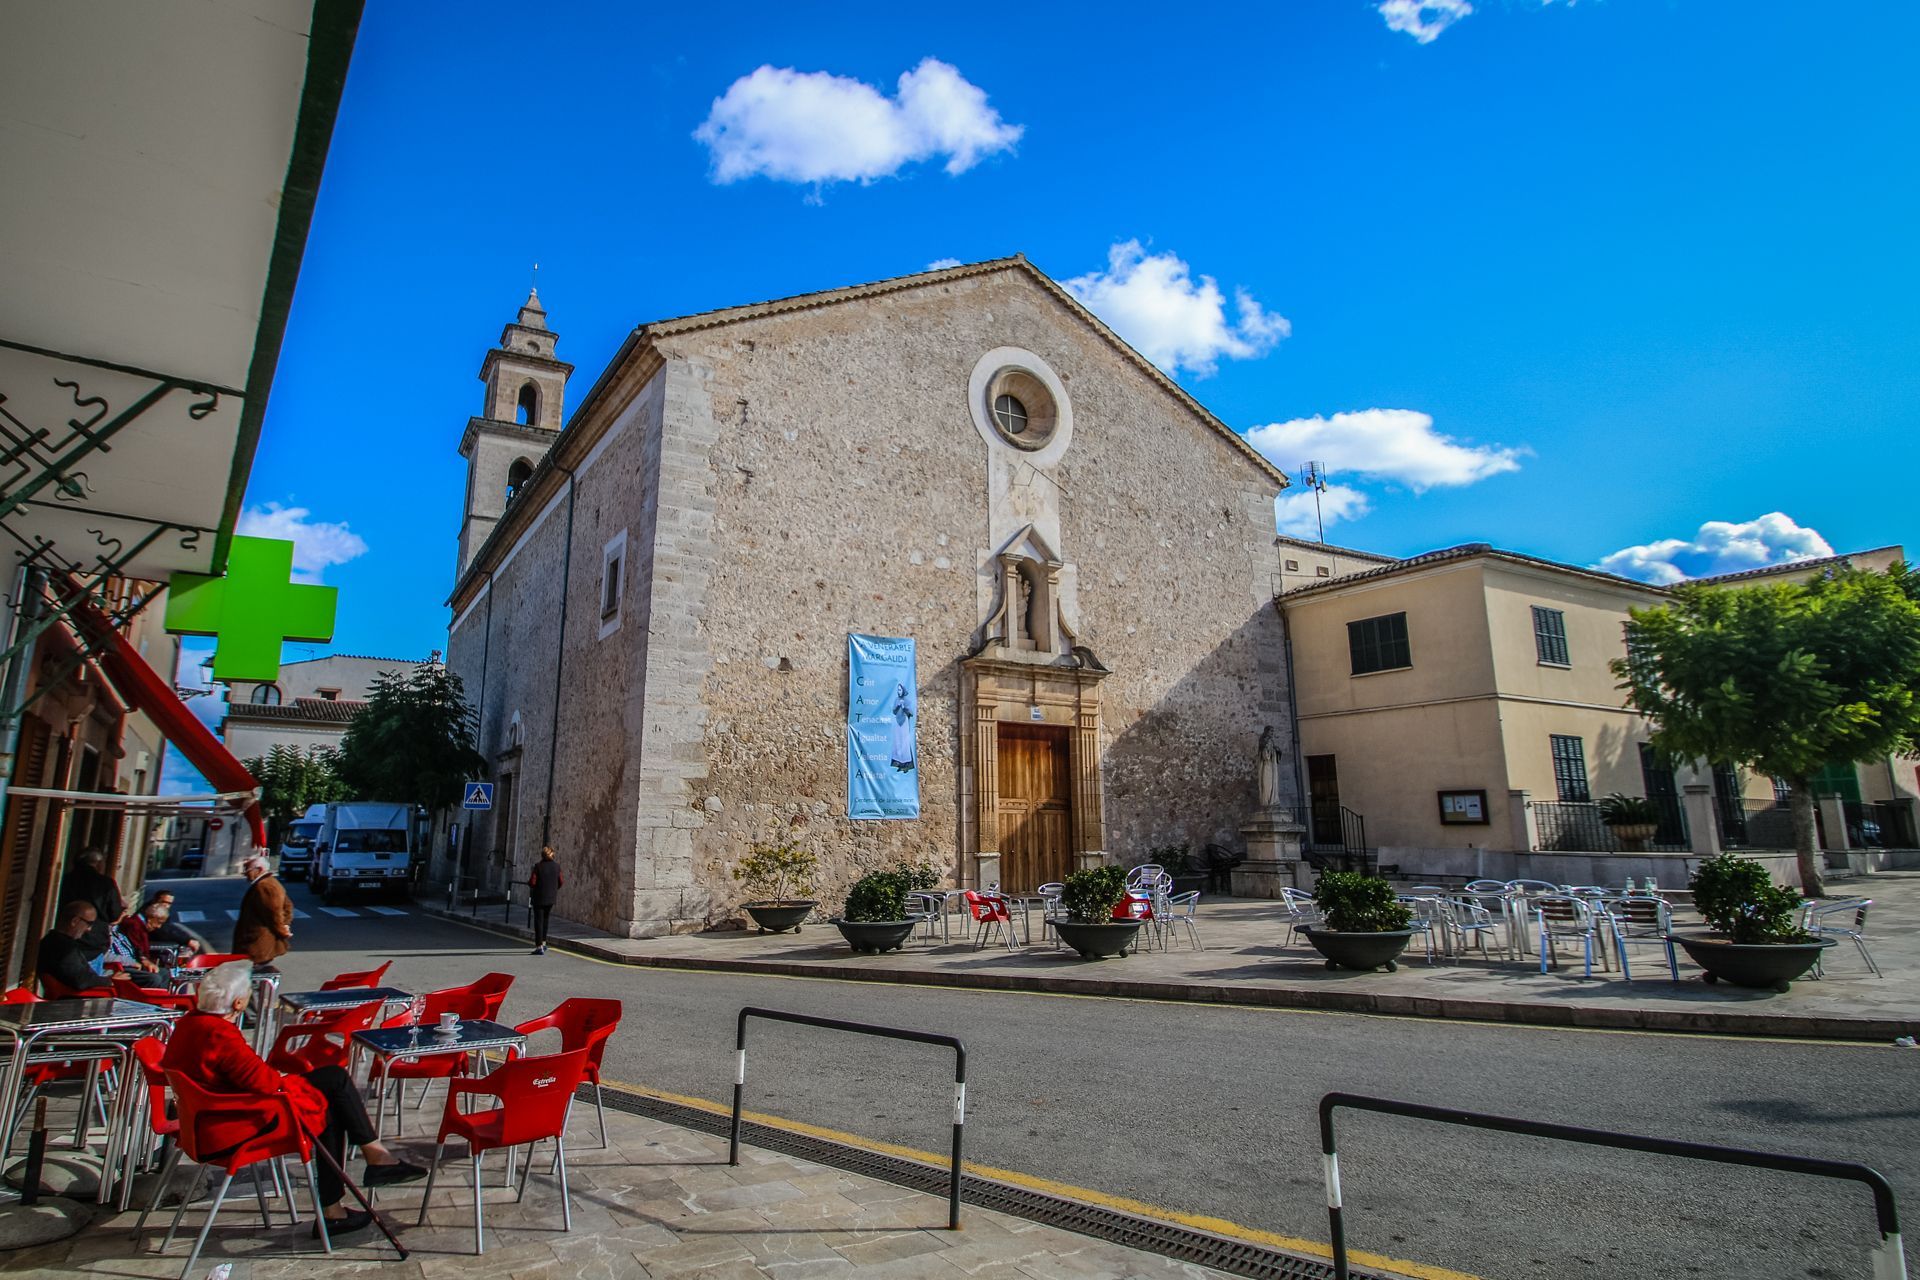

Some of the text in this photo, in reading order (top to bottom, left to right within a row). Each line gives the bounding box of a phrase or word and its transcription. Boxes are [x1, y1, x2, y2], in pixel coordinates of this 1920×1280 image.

[868, 642, 913, 652] VENERABLE
[862, 653, 908, 663] MARGALIDA
[856, 694, 880, 705] Amor
